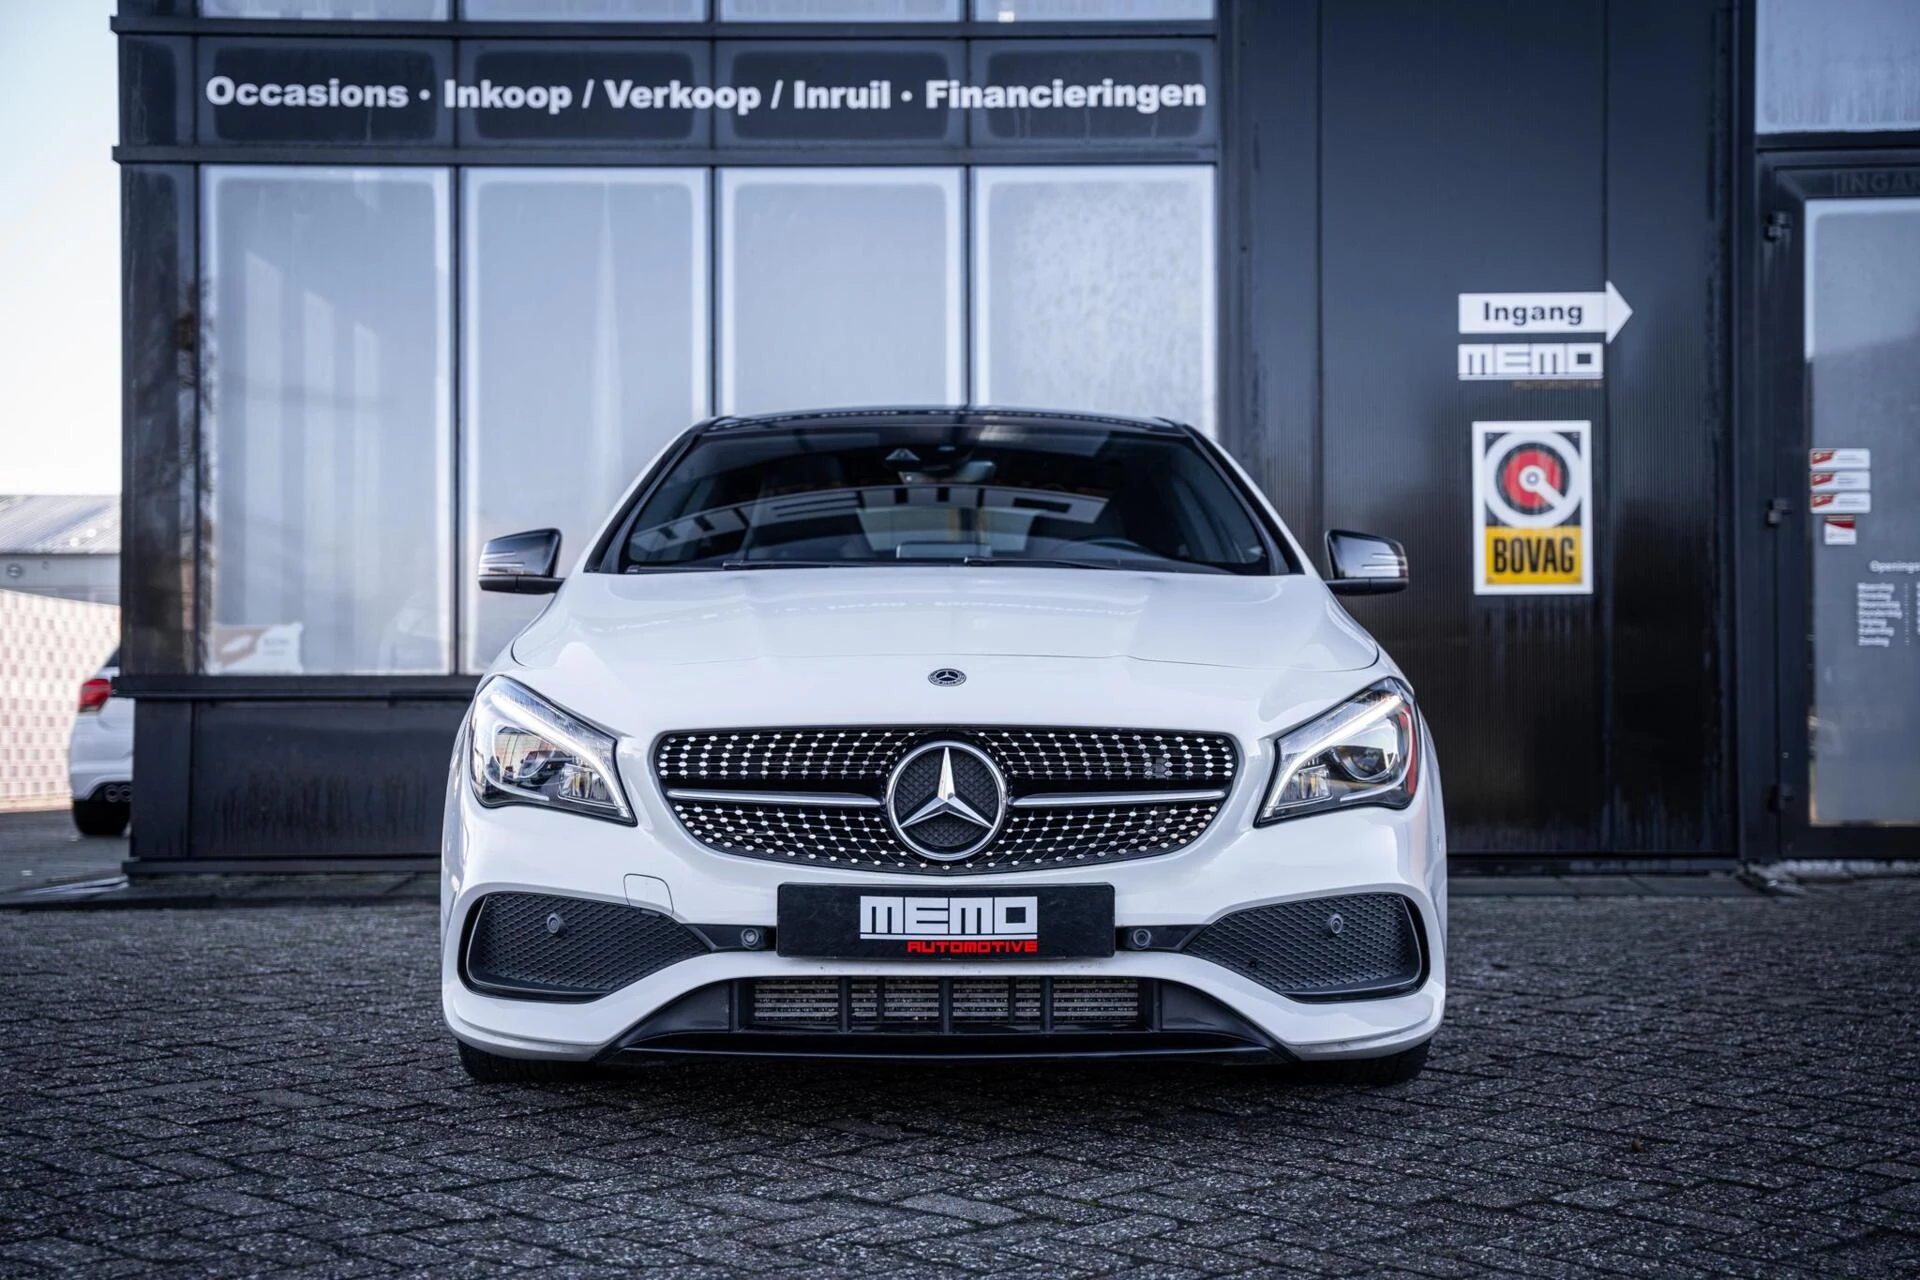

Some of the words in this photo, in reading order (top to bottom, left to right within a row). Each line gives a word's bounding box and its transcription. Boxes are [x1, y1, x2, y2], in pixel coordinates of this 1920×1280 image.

[206, 76, 408, 107] Occasions
[444, 79, 572, 115] Inkoop
[603, 79, 761, 116] Verkoop
[794, 80, 891, 109] Inruil
[926, 78, 1207, 114] Financieringen
[1484, 301, 1583, 326] Ingang
[1457, 342, 1603, 376] MEMO
[1493, 537, 1574, 574] BOVAG
[859, 895, 1038, 935] MEMO
[907, 940, 1038, 954] AUTOMOTIVE
